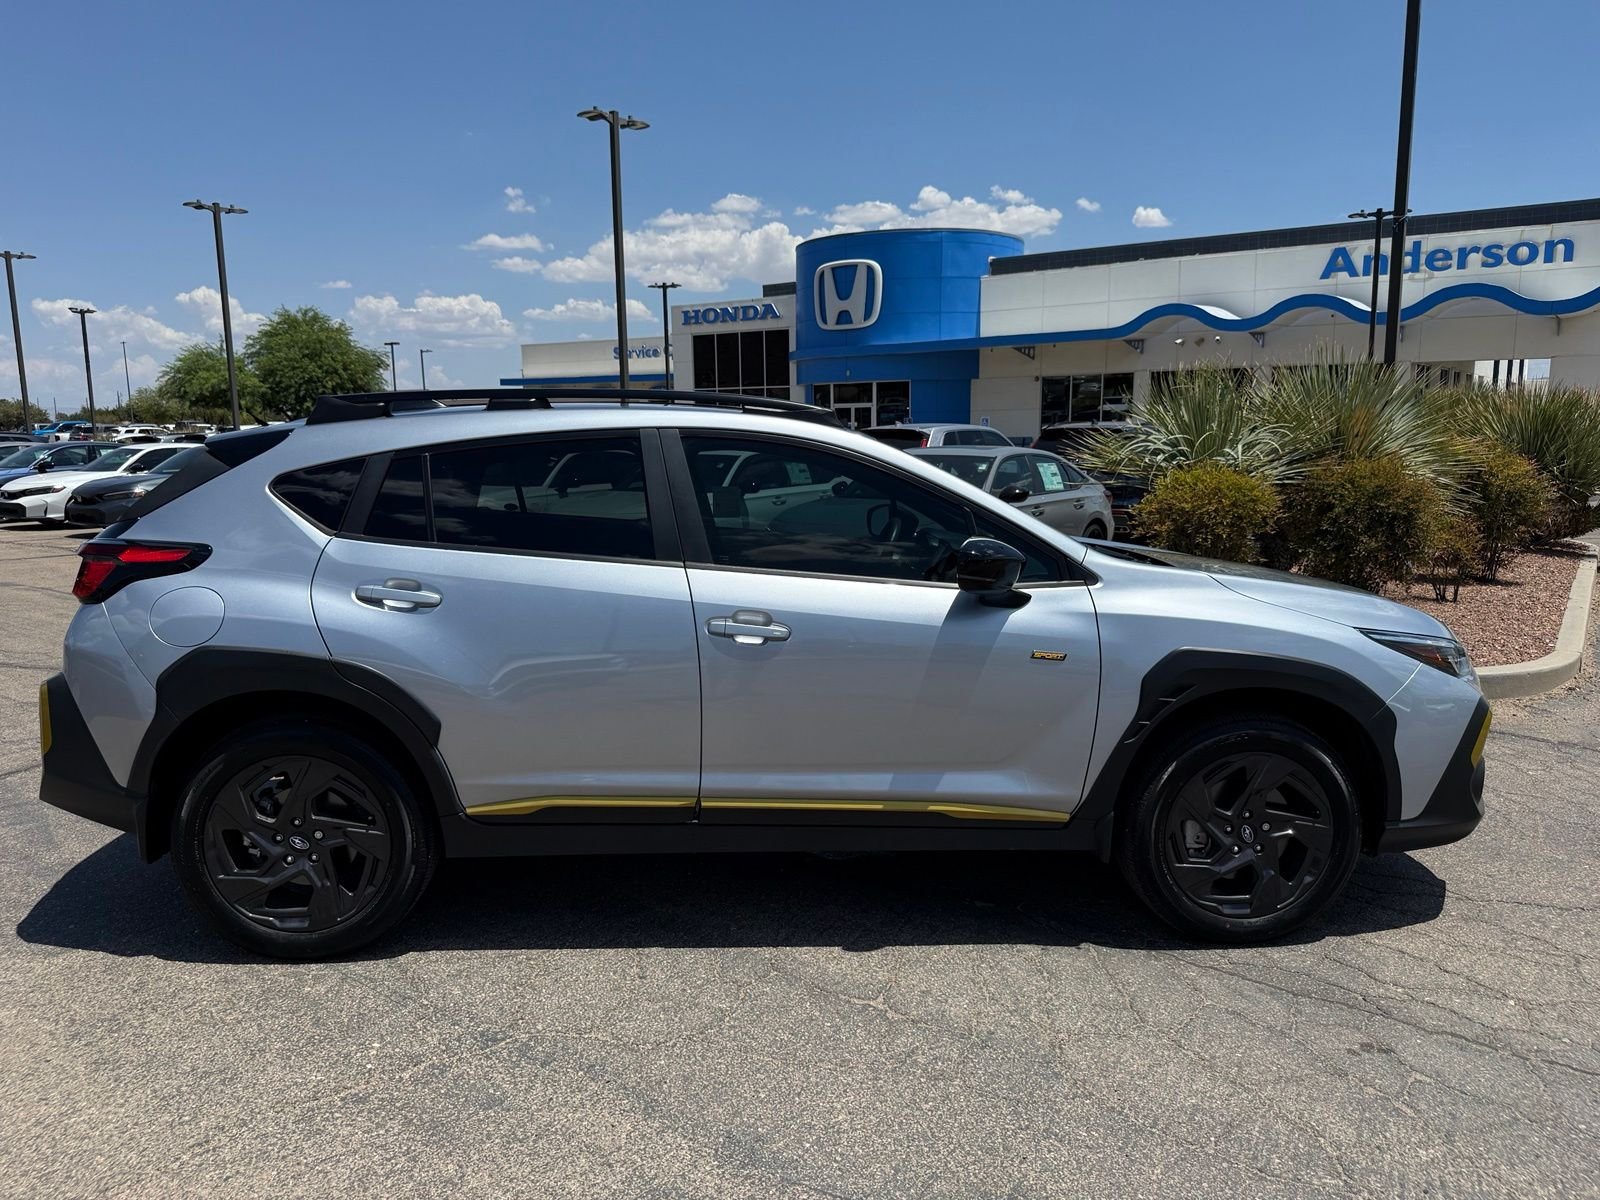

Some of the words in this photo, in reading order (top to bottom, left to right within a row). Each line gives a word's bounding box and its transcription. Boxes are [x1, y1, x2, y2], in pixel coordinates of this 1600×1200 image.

[1319, 238, 1574, 280] Anderson
[681, 303, 780, 325] HONDA
[613, 344, 660, 359] Srvice
